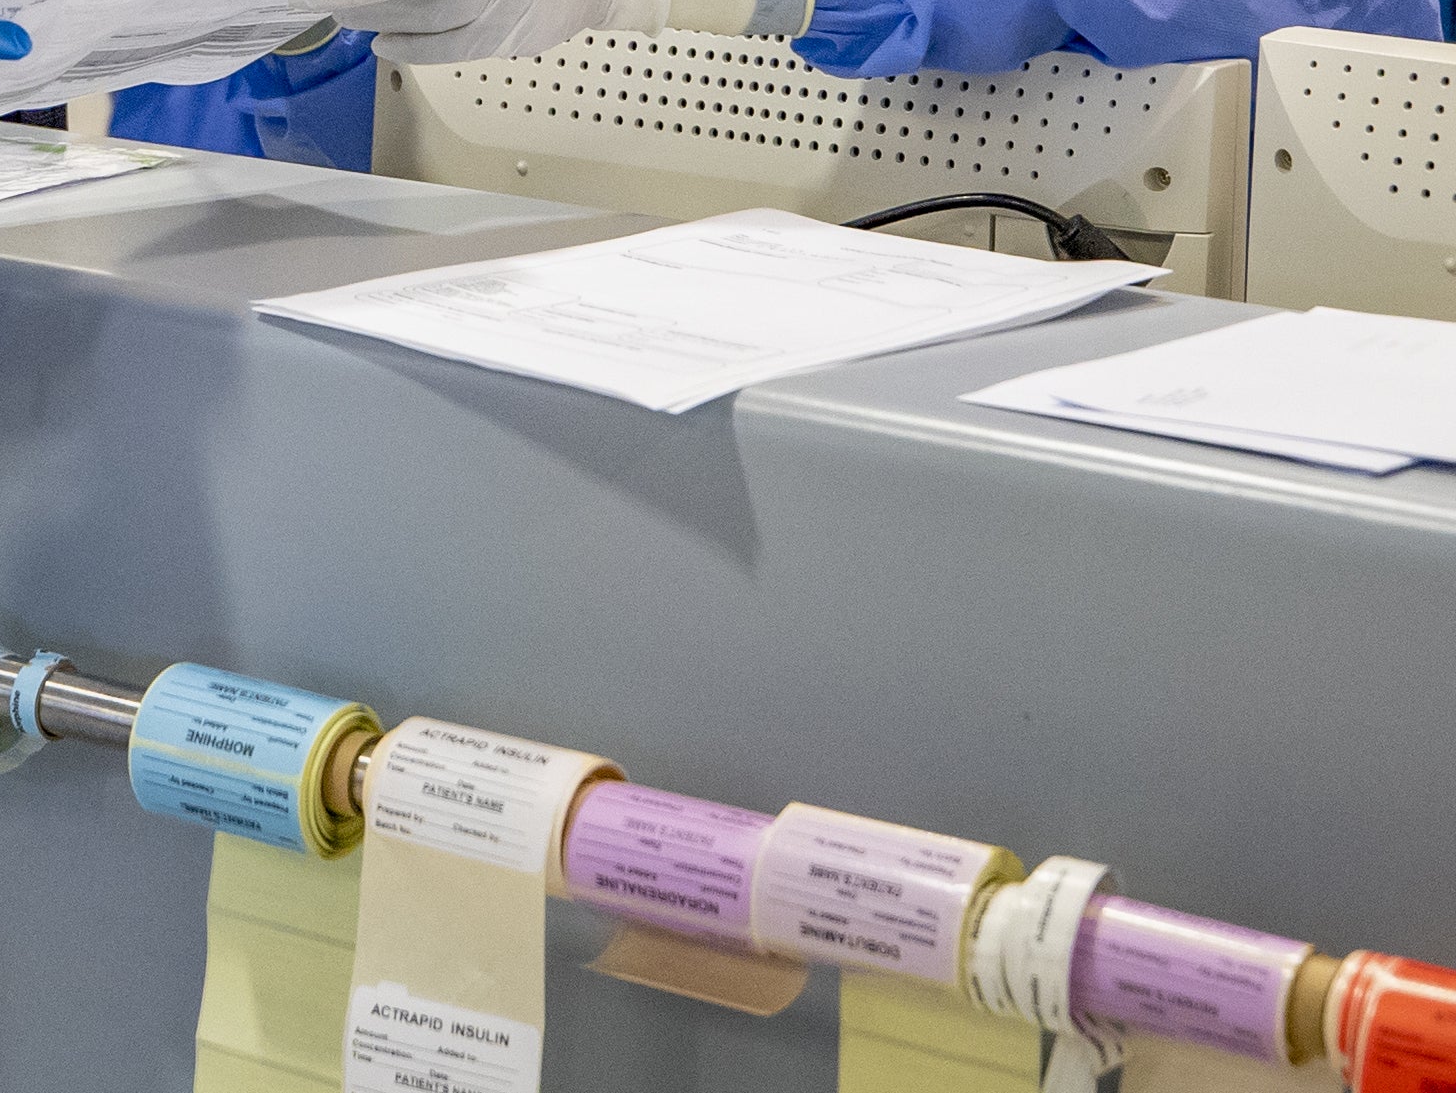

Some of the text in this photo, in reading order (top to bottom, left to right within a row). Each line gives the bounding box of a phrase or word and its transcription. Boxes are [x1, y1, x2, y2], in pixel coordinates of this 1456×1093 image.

[185, 729, 255, 756] MORPHINE
[419, 728, 551, 766] ACTRAPID INSULIN
[422, 781, 505, 813] PATIENT'S NAME
[370, 1003, 510, 1047] ACTRAPID INSULIN
[437, 1045, 465, 1058] Added
